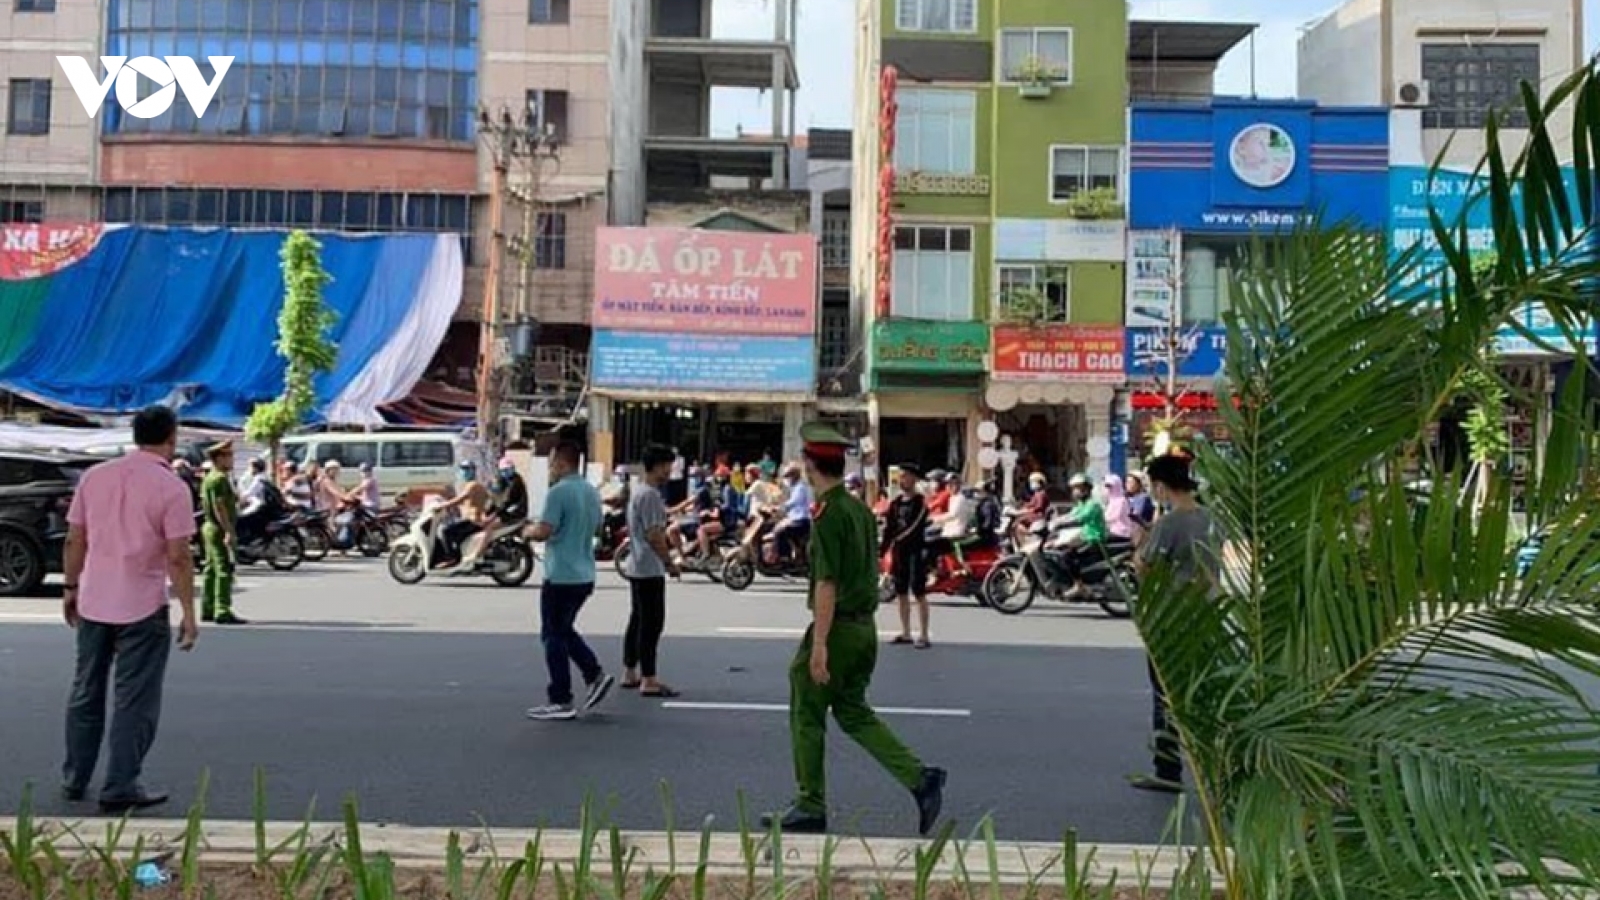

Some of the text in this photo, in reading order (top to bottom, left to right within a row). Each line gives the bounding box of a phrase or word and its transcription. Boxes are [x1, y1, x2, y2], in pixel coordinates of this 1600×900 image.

[608, 240, 661, 273] ĐÁ
[673, 233, 722, 277] ỐP
[1086, 351, 1125, 370] CAO
